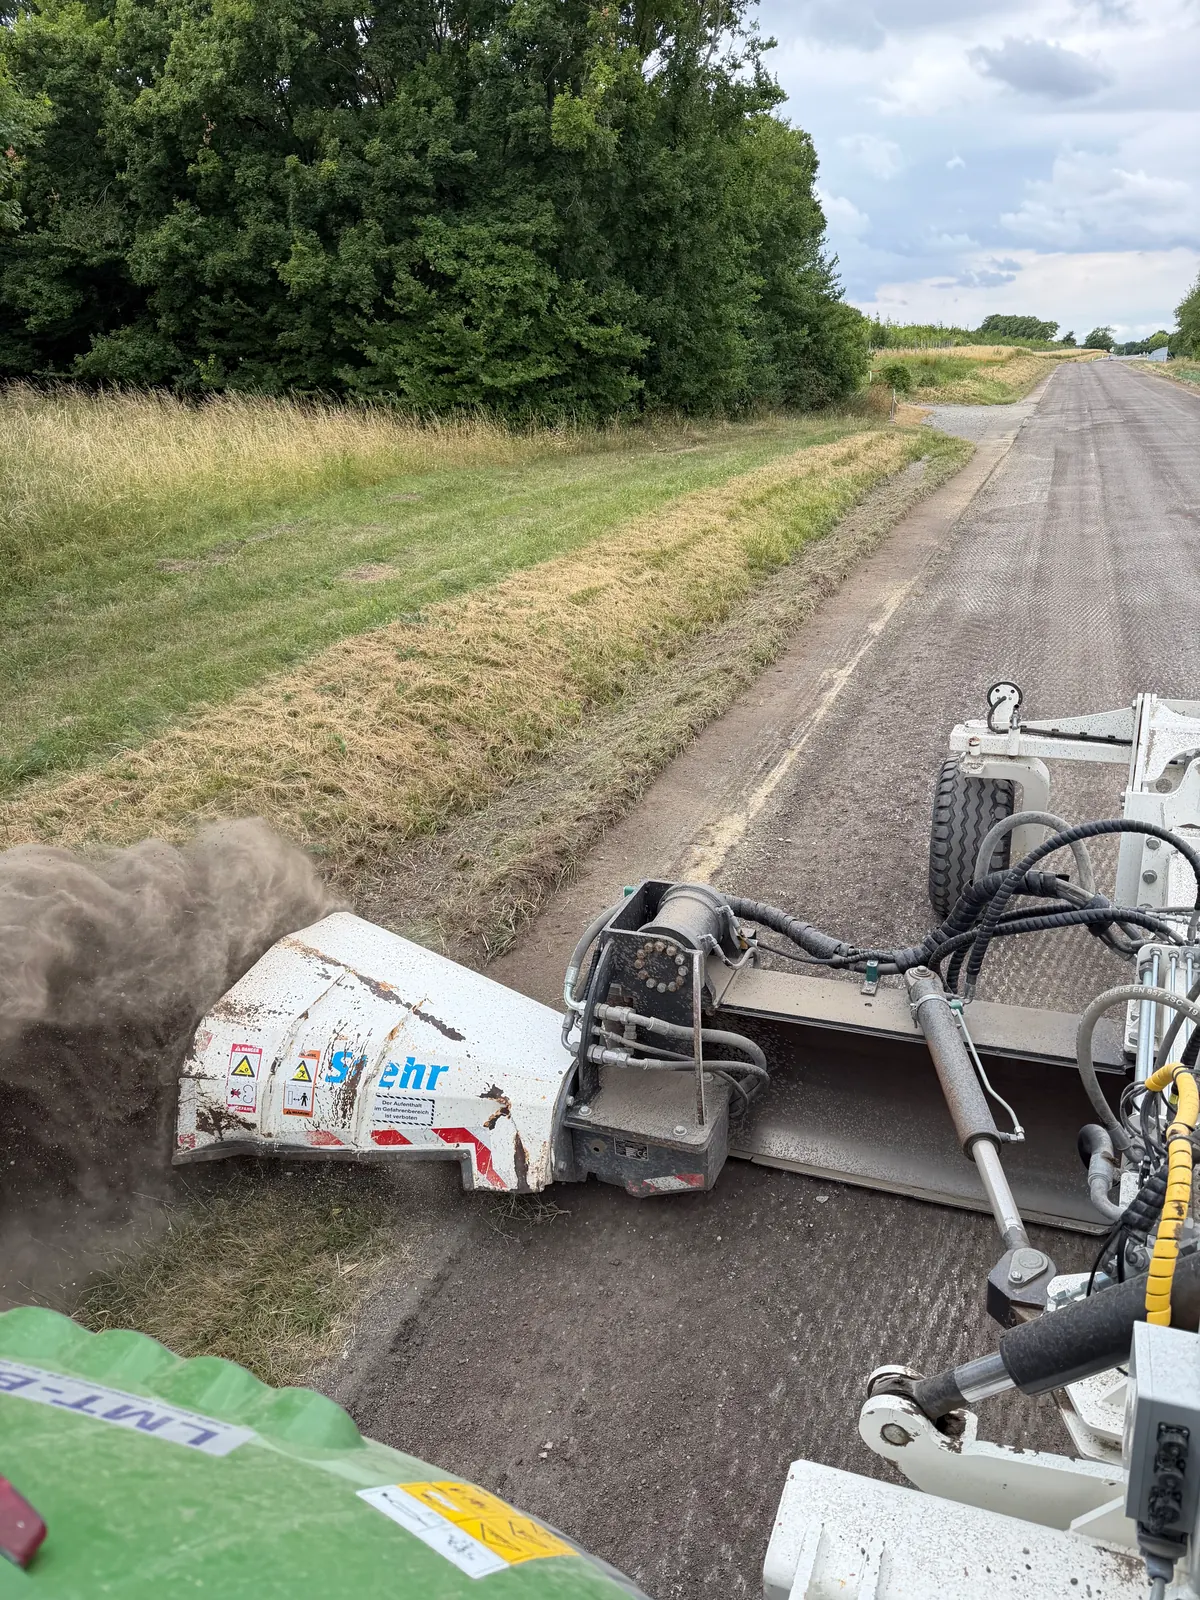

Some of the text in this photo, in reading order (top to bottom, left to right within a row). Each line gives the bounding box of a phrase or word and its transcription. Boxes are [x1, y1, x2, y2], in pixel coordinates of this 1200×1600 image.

[1164, 993, 1184, 1006] 2SC
[1188, 1006, 1199, 1016] 19
[325, 1051, 449, 1090] Sehr
